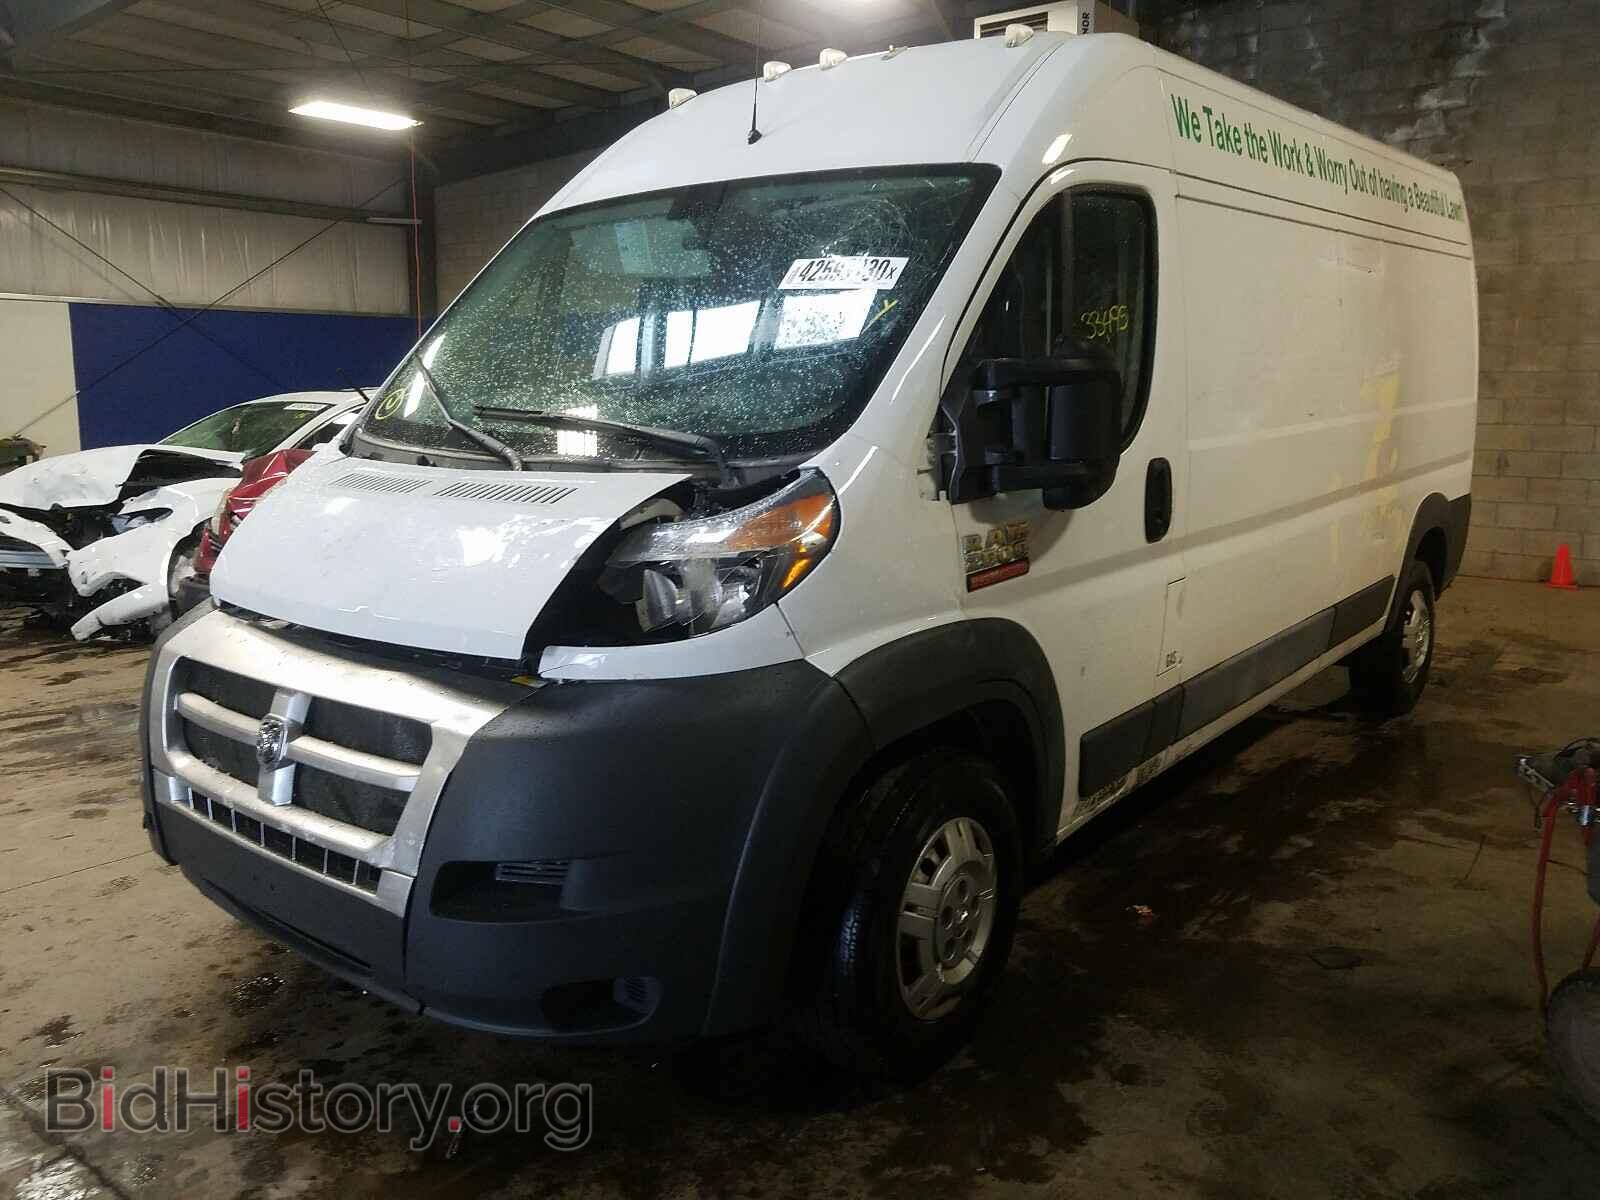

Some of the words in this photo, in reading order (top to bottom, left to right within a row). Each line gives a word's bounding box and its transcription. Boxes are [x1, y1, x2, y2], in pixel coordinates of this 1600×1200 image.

[1170, 93, 1202, 143] We
[1202, 105, 1243, 156] Take
[1243, 122, 1269, 164] the
[1267, 128, 1305, 175] Work
[1305, 142, 1316, 178] &
[1313, 145, 1348, 196] Worry
[1348, 157, 1369, 195] Out
[1368, 167, 1379, 199] of
[1377, 168, 1409, 214] having
[1413, 181, 1446, 218] Beautiful
